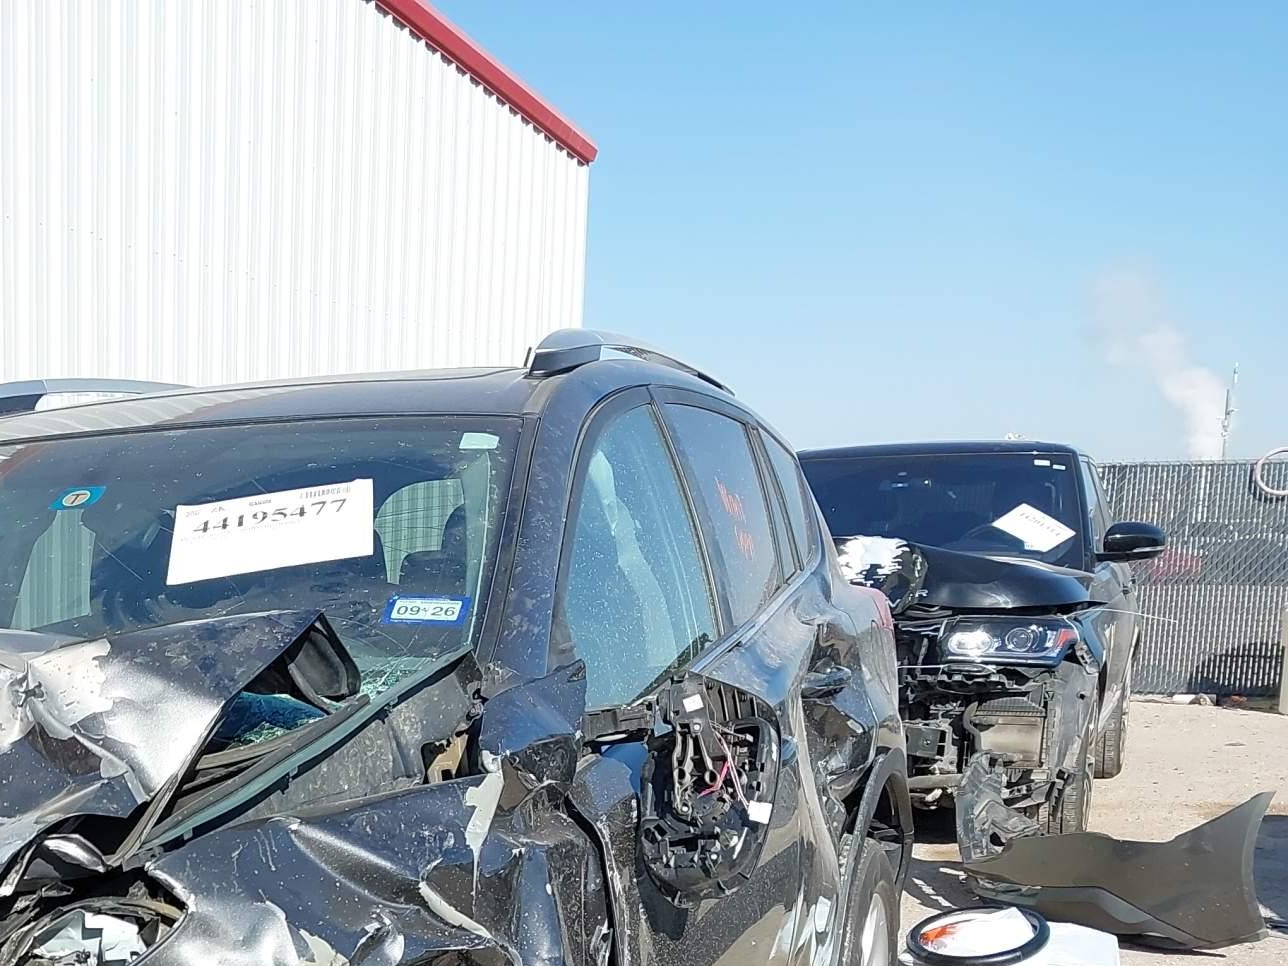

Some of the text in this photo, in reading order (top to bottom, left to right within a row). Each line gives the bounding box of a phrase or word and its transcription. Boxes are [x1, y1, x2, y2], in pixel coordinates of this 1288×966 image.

[192, 497, 349, 534] 44195477
[396, 605, 456, 617] 09 26
